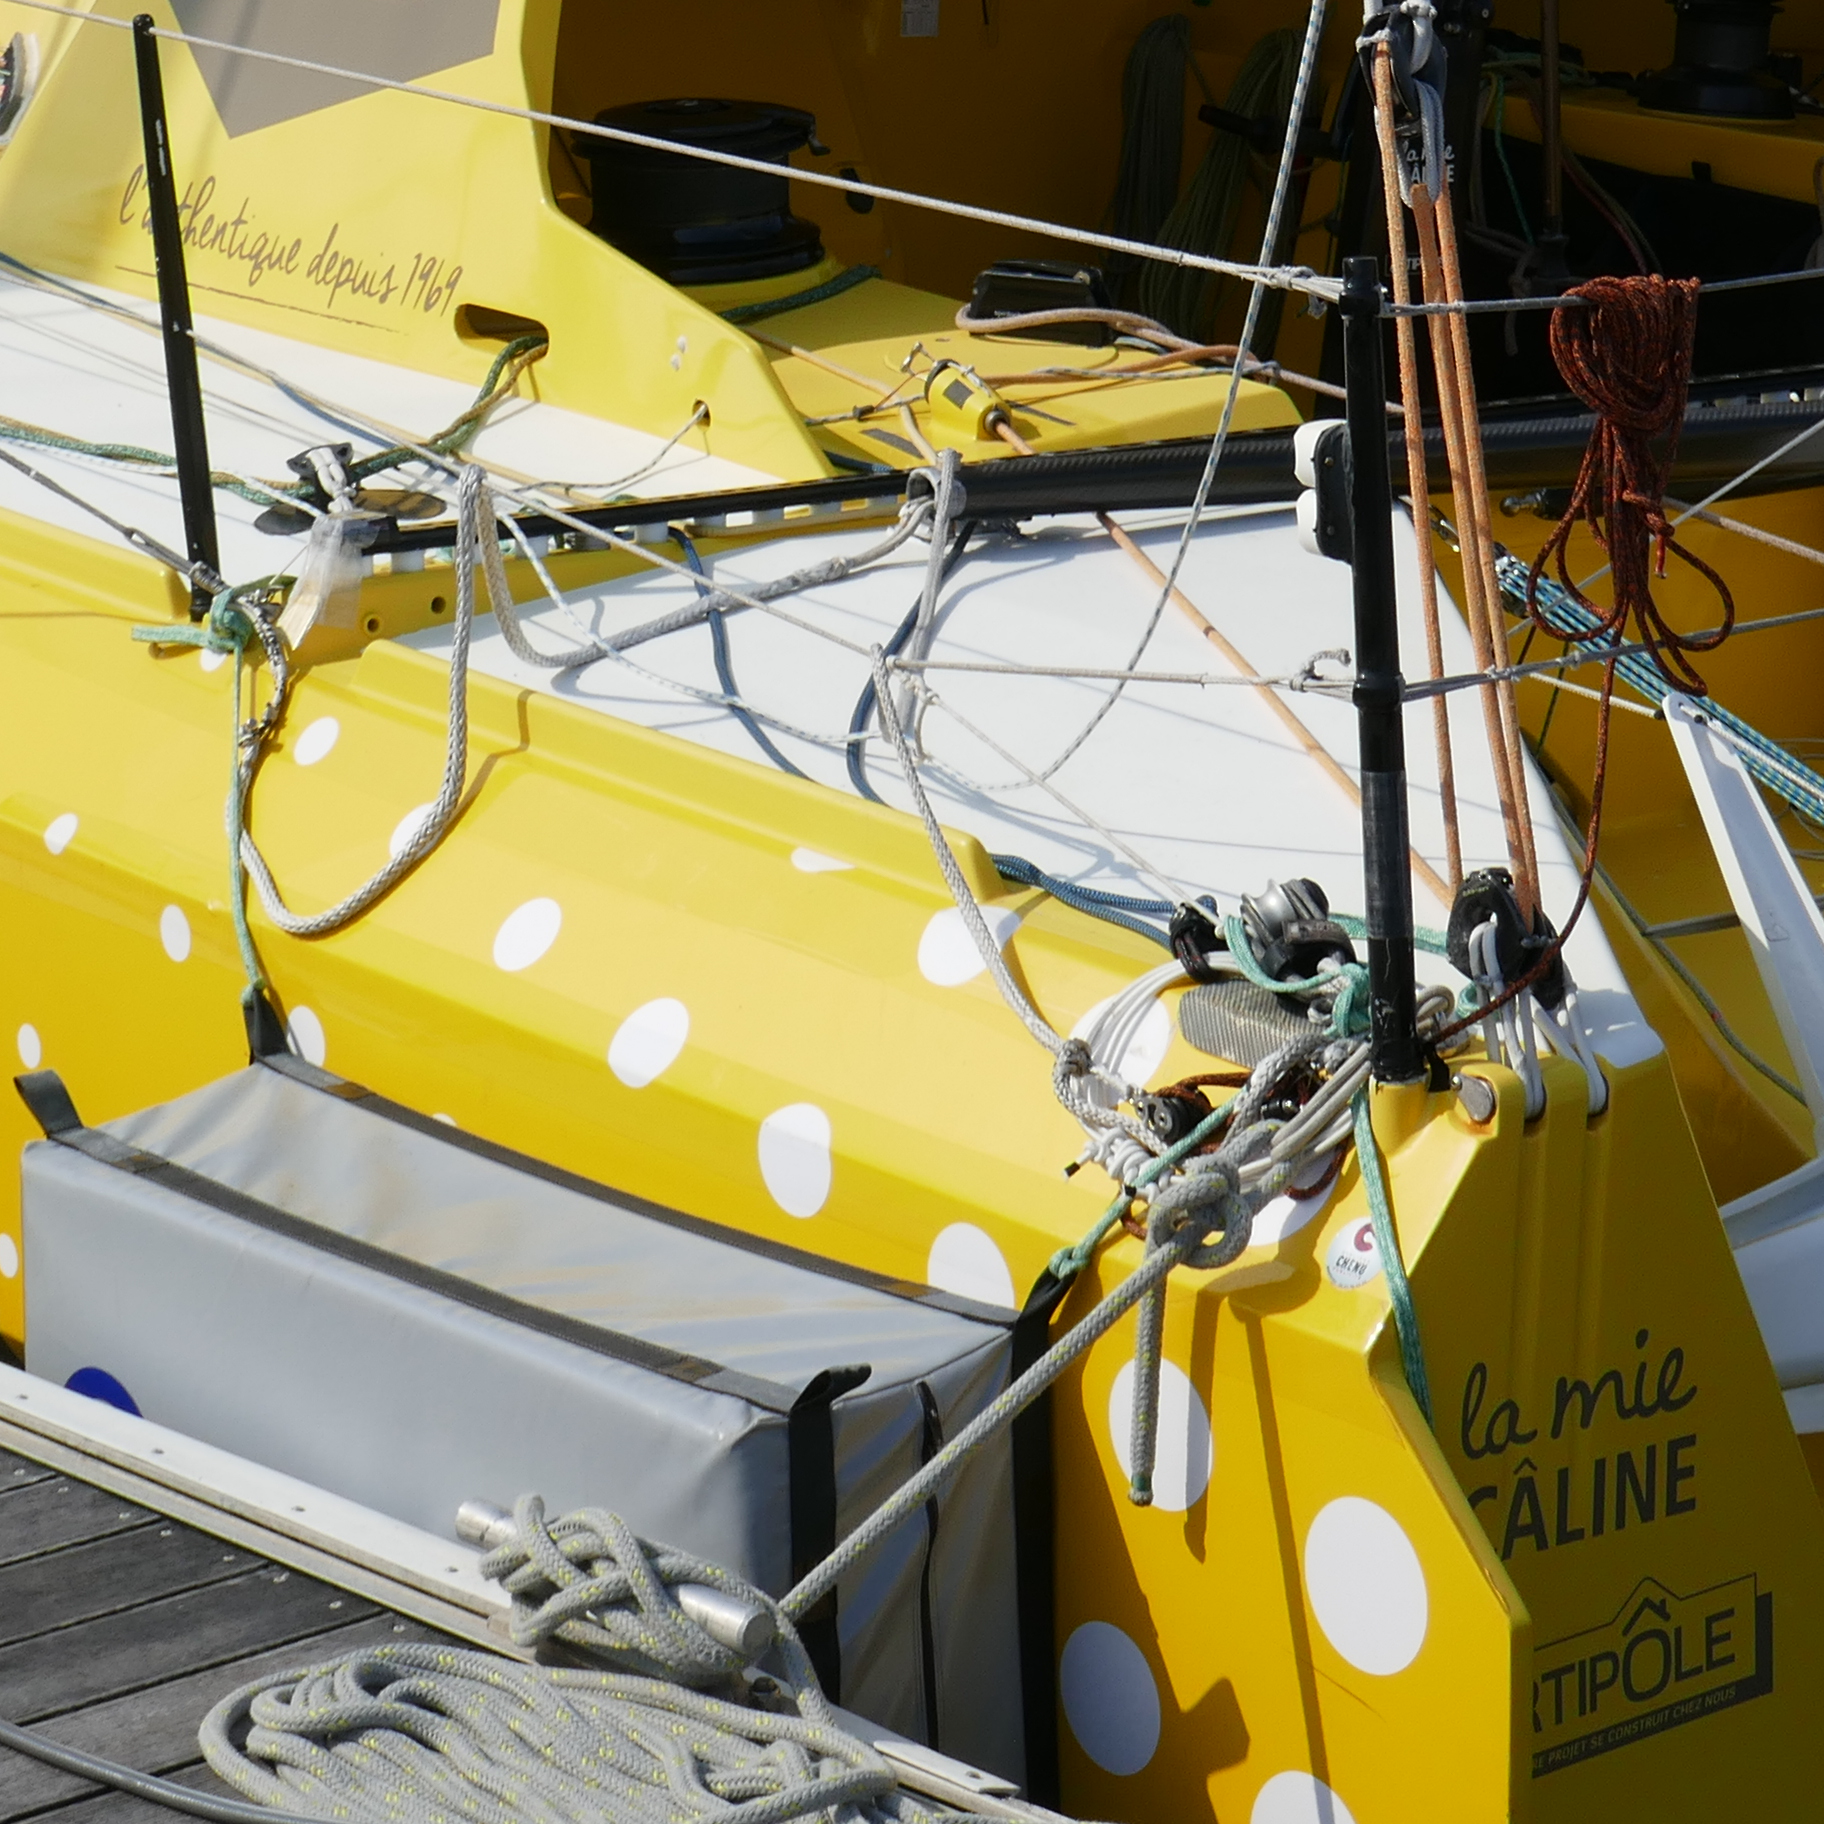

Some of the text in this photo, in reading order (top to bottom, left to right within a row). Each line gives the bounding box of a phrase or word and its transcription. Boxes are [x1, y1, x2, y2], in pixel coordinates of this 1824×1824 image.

[306, 223, 399, 309] depuis
[400, 253, 464, 318] 1969
[1461, 1329, 1697, 1460] la mie
[1547, 1742, 1588, 1765] PROJET
[1590, 1734, 1603, 1749] SE
[1607, 1709, 1670, 1743] CONSTRUIT
[1672, 1700, 1702, 1719] CHEZ
[1704, 1686, 1737, 1707] NOUS
